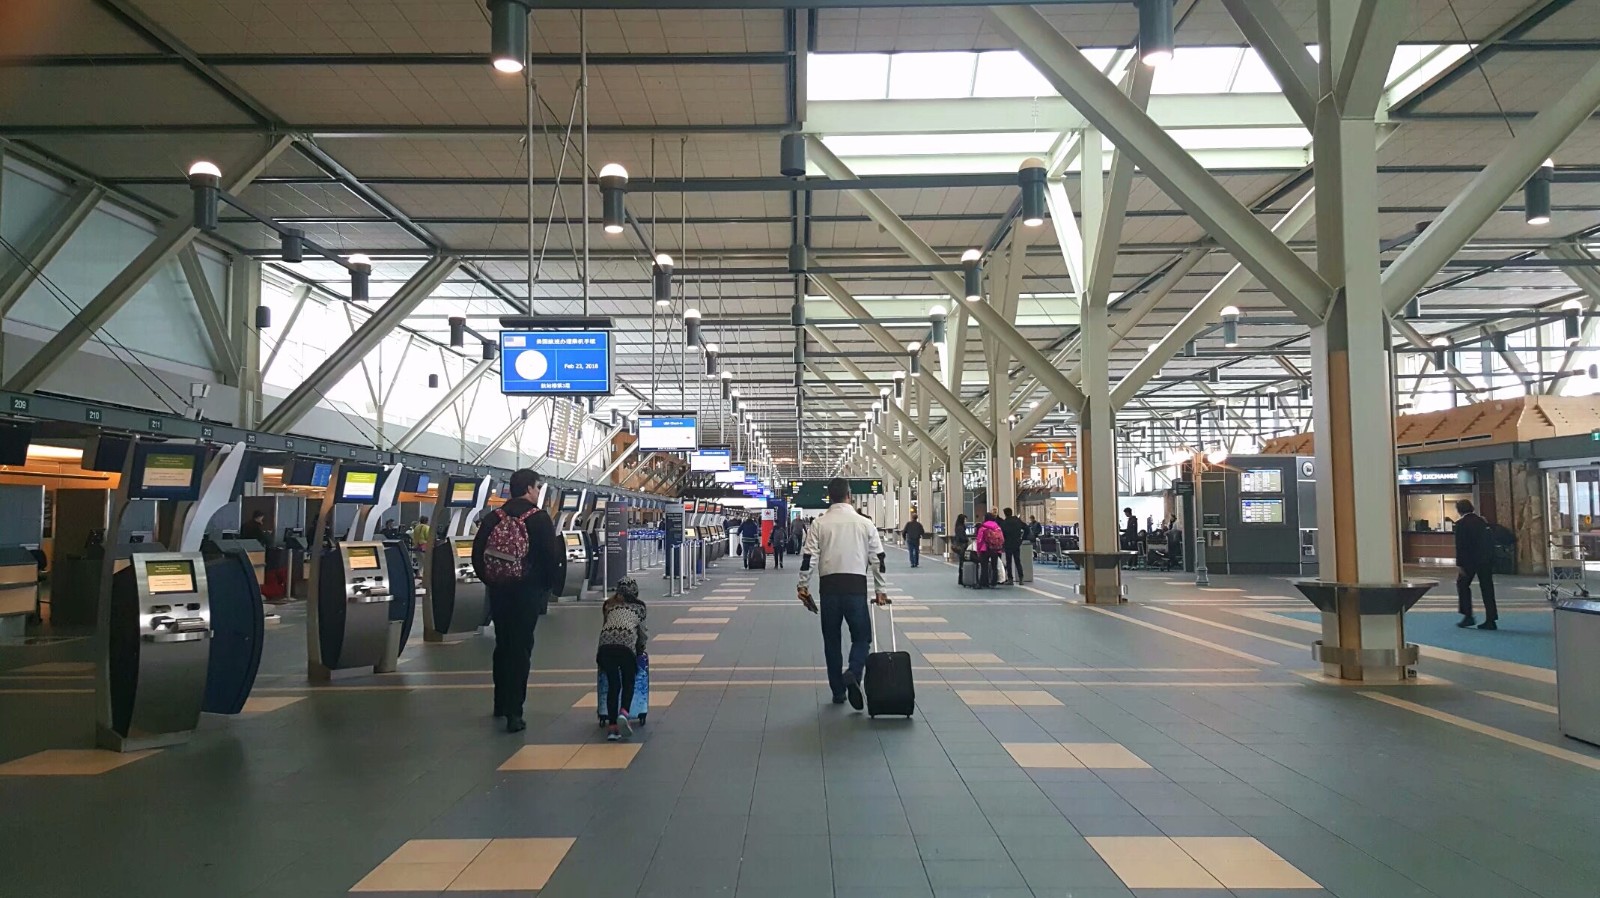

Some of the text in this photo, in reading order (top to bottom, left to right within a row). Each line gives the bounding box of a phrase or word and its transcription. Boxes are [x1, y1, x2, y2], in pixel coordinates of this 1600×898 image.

[14, 399, 27, 409] 209
[89, 410, 100, 419] 210
[151, 420, 161, 428] 211
[203, 428, 212, 436] 212
[248, 434, 256, 442] 213
[1553, 572, 1581, 582] YVR
